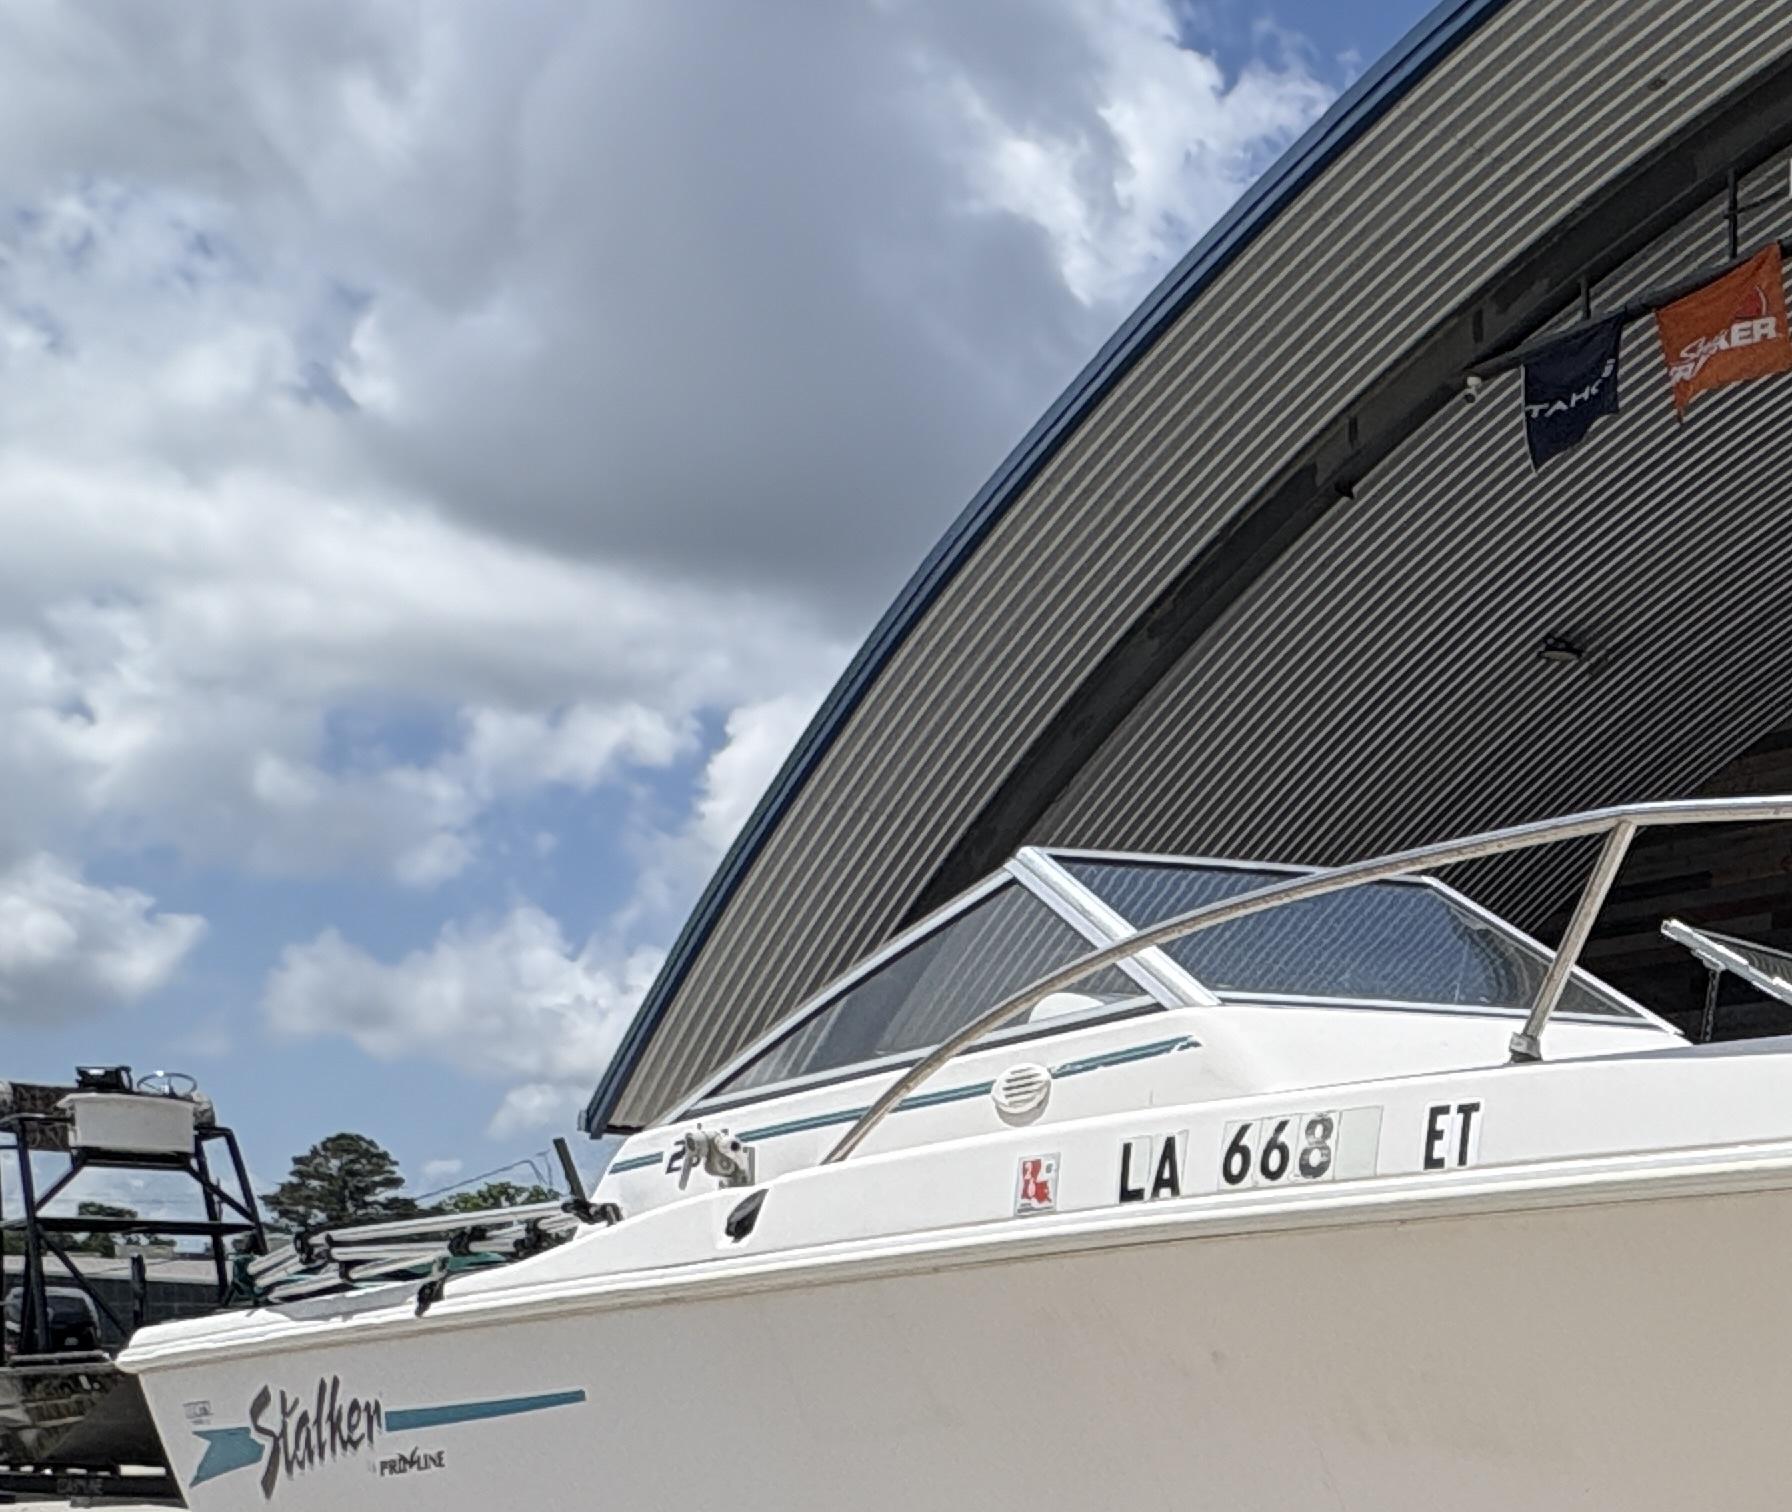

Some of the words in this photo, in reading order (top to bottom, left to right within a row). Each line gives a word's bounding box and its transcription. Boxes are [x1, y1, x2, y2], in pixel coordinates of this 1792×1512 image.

[1119, 1136, 1181, 1204] LA
[1221, 1112, 1335, 1185] 668
[1422, 1102, 1481, 1170] ET
[250, 1374, 383, 1501] Stalker
